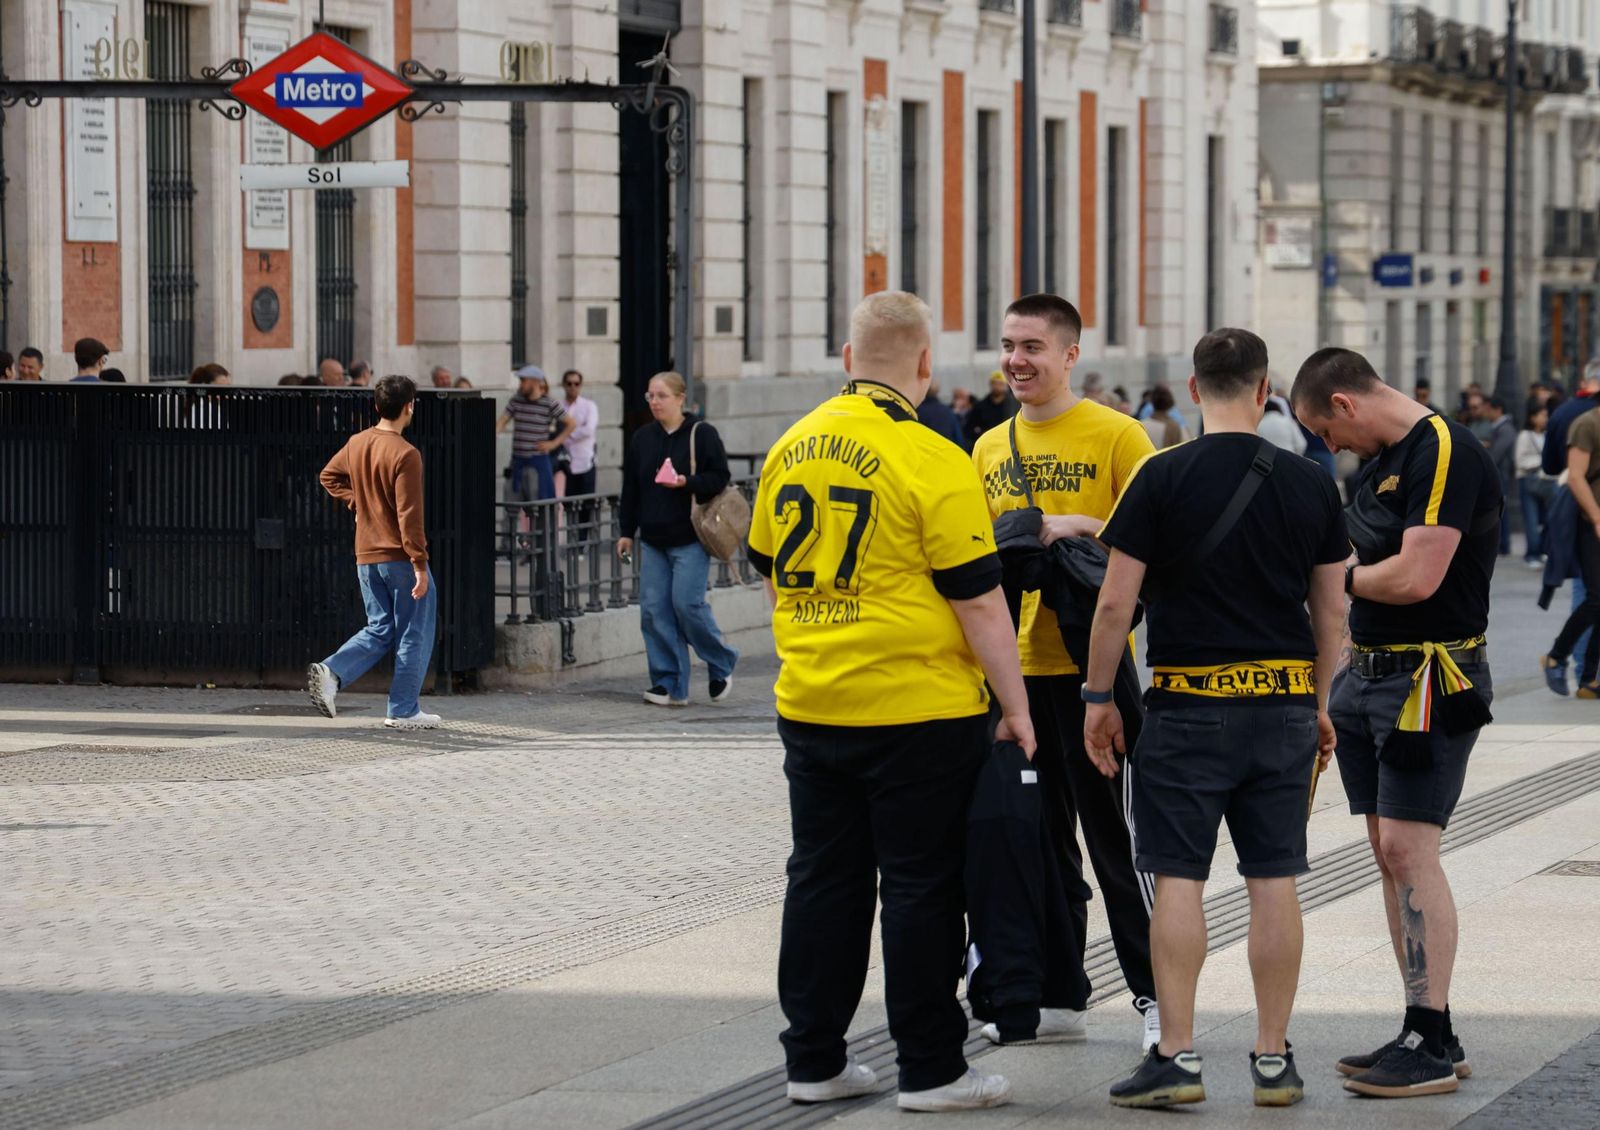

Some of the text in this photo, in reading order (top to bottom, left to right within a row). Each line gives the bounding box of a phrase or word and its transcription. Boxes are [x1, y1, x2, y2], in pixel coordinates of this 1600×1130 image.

[283, 77, 357, 101] Metro
[308, 167, 341, 183] Sol
[783, 434, 881, 479] DORTMUND
[999, 457, 1097, 481] WESTFALEN
[774, 484, 879, 595] 27
[791, 600, 861, 624] ADEYEMI
